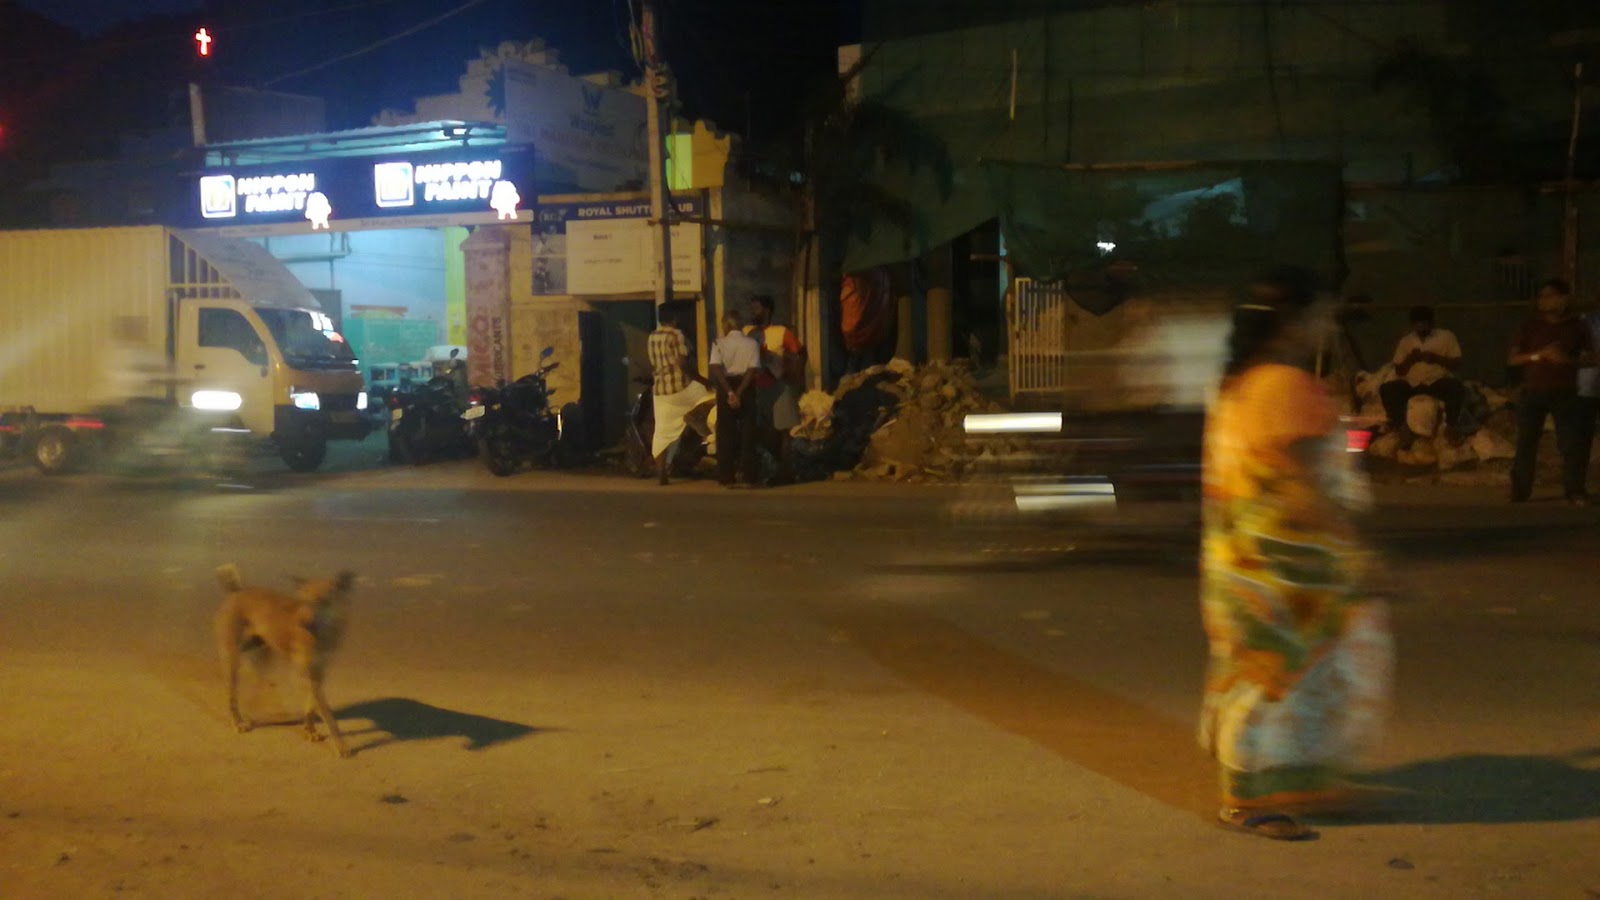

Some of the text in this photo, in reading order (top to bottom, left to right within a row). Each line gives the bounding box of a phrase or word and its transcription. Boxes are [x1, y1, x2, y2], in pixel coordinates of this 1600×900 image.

[415, 160, 502, 184] NIPPON
[237, 173, 315, 195] NIPPON
[424, 180, 492, 201] PAINT
[245, 192, 307, 213] PAINT
[578, 205, 613, 218] ROYAL
[615, 204, 653, 217] SHUTT
